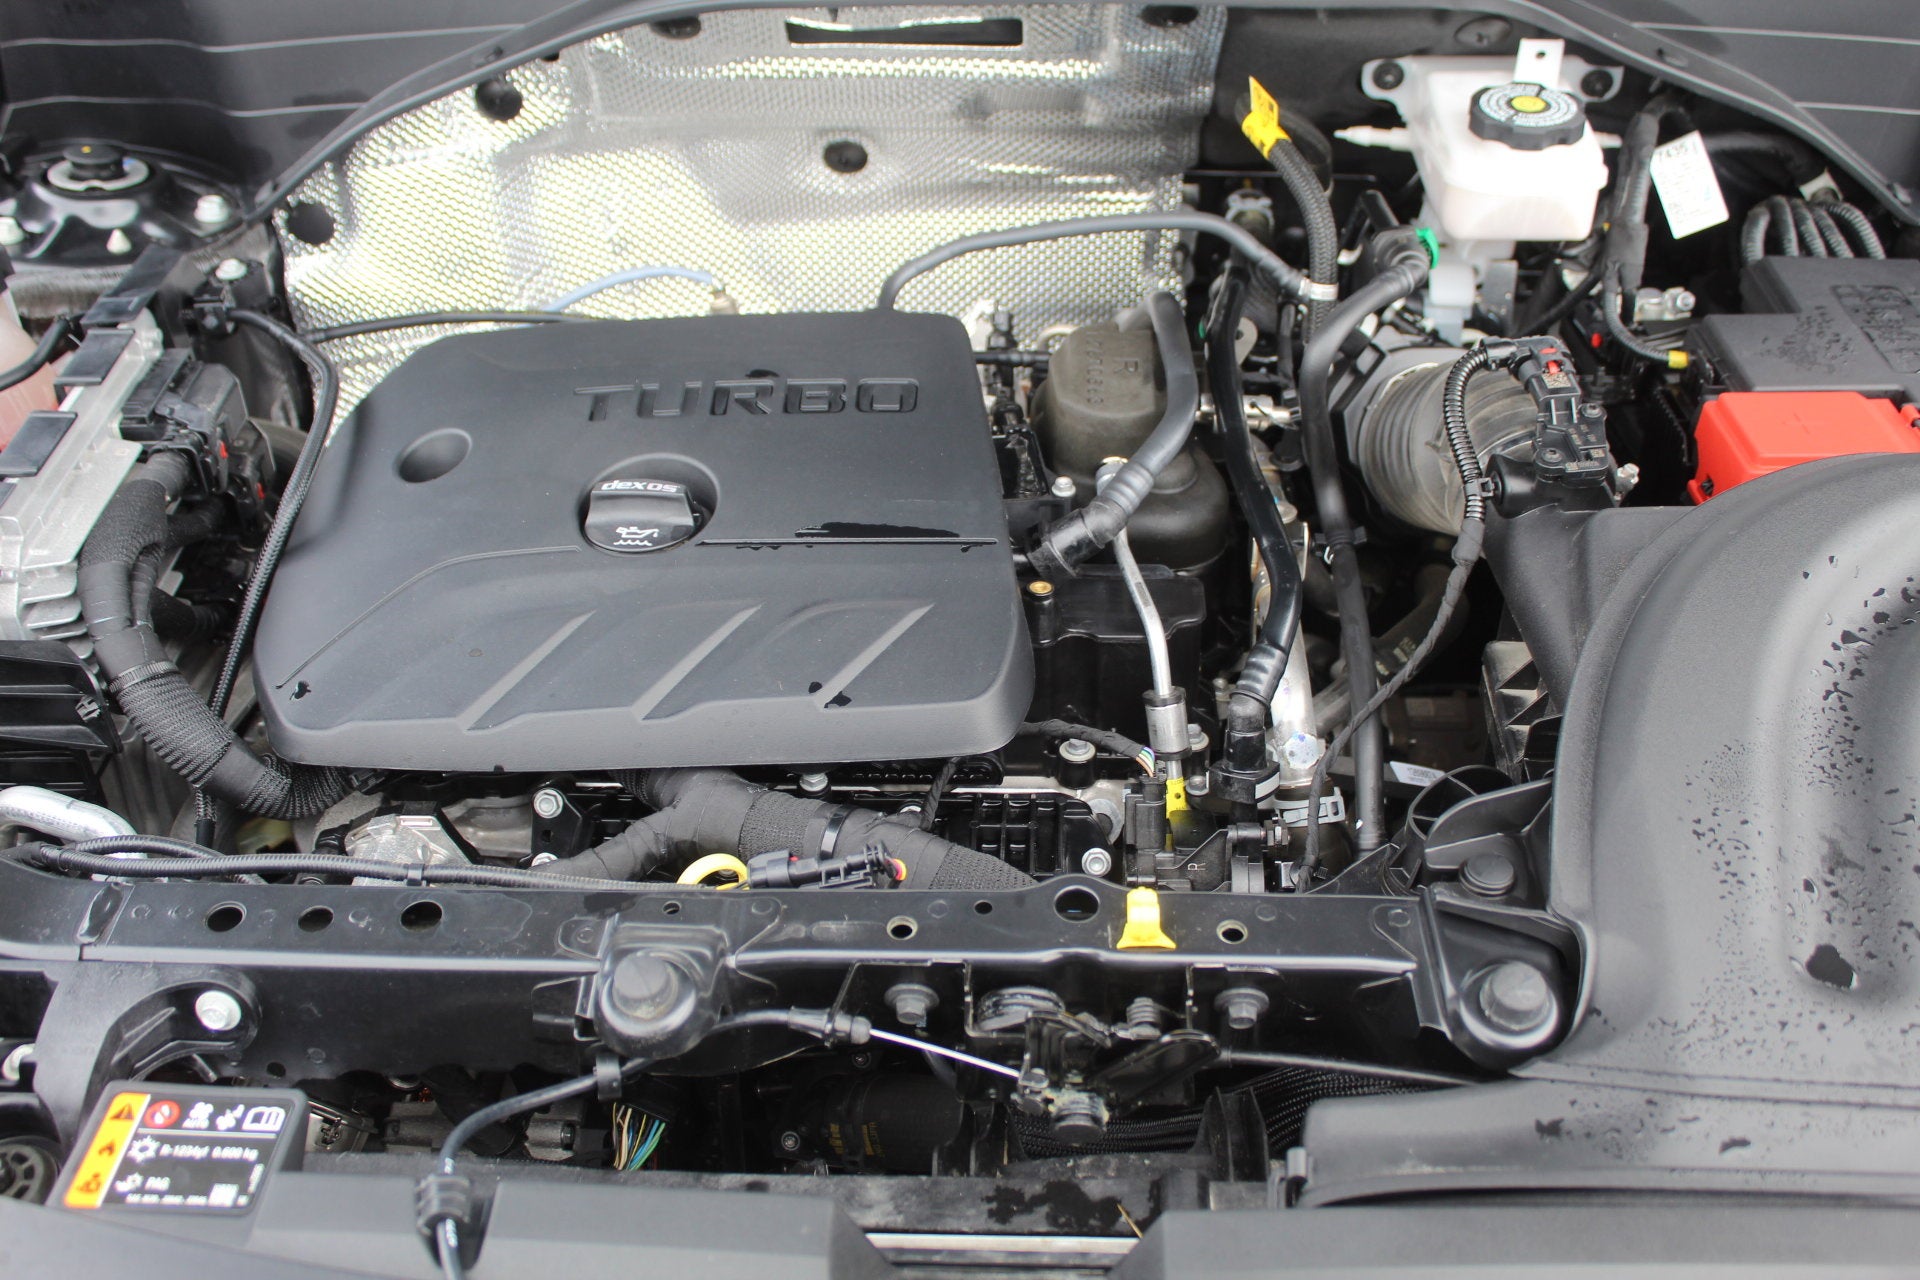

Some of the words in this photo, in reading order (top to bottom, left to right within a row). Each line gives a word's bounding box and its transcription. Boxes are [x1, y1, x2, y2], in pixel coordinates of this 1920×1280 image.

[1113, 357, 1138, 375] R
[573, 377, 920, 422] TURBO
[601, 479, 680, 493] dexos
